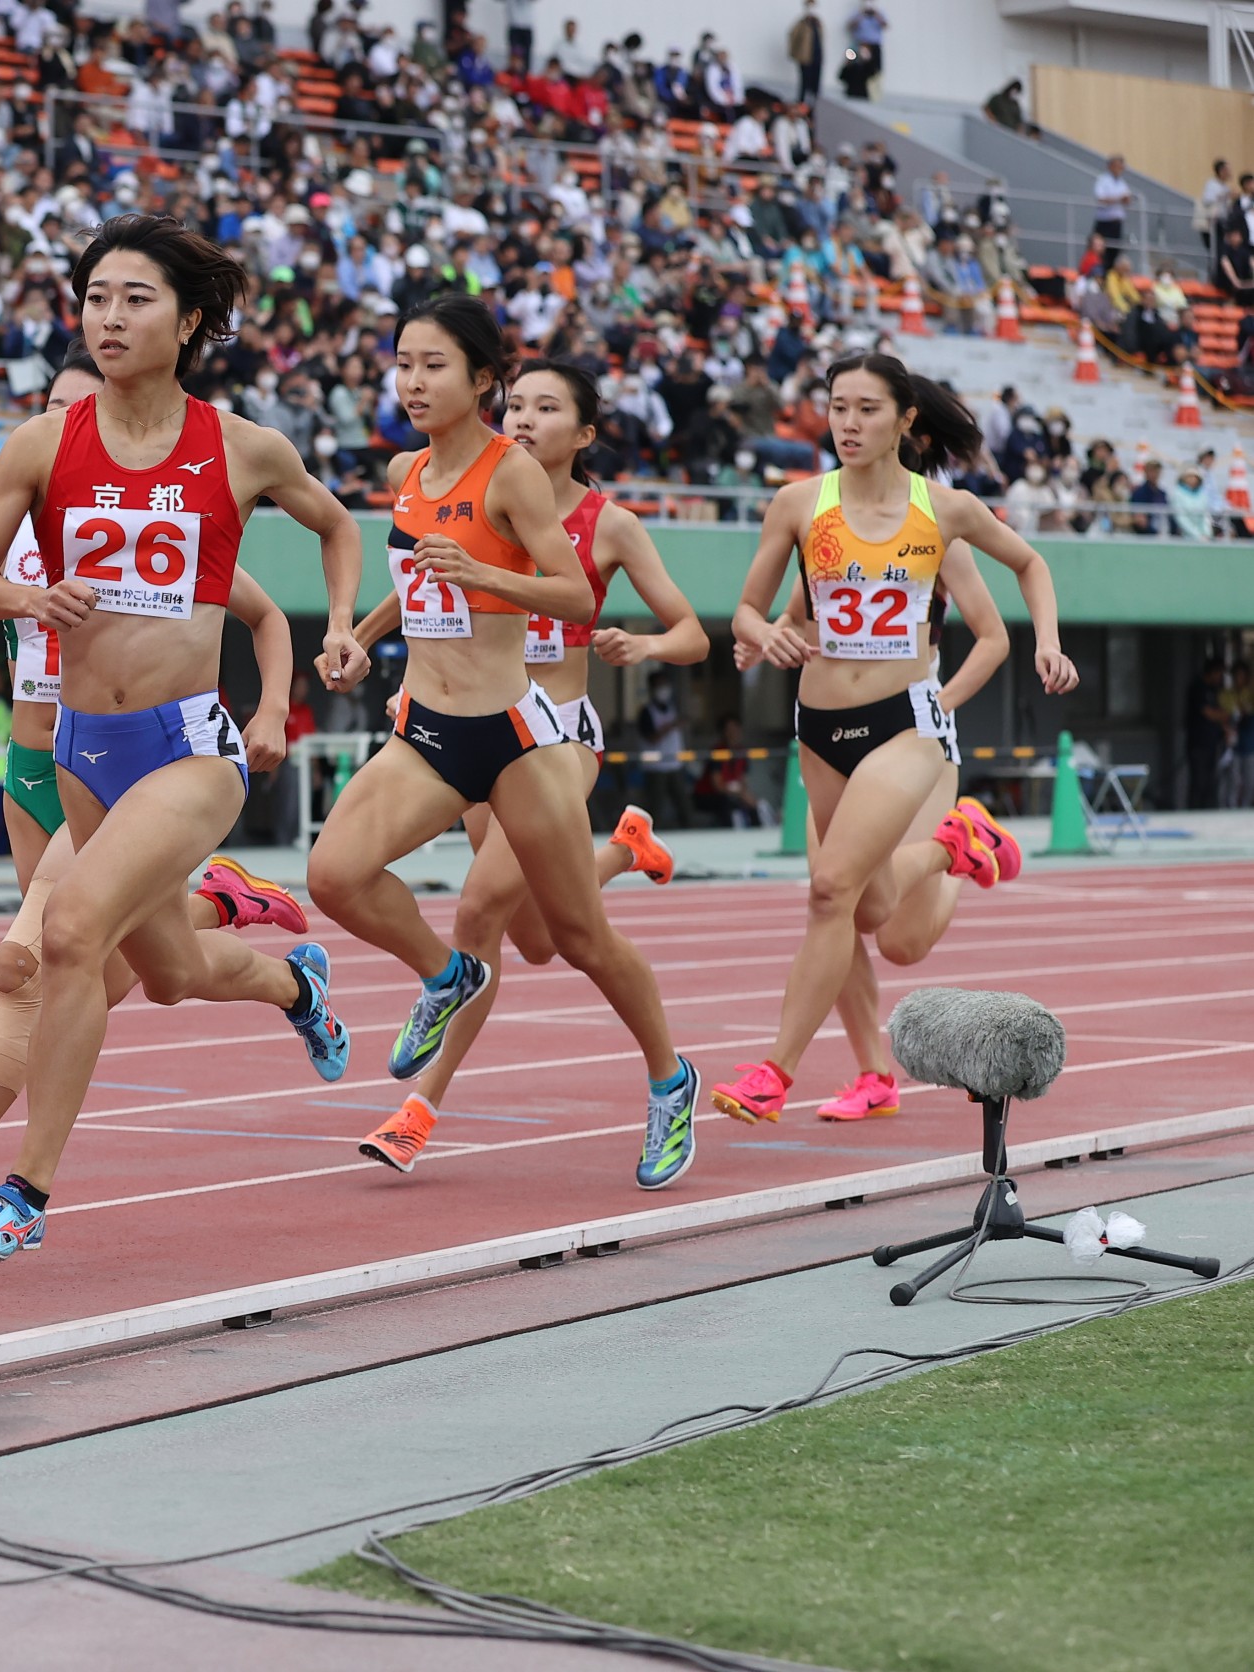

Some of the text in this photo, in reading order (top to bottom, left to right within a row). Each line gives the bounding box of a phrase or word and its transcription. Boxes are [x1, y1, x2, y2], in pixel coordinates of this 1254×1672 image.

[92, 483, 185, 512] 京都
[74, 517, 187, 586] 26
[911, 545, 936, 556] asics
[827, 587, 908, 637] 32
[208, 703, 239, 757] 2
[577, 701, 595, 746] 4
[843, 726, 869, 740] asics
